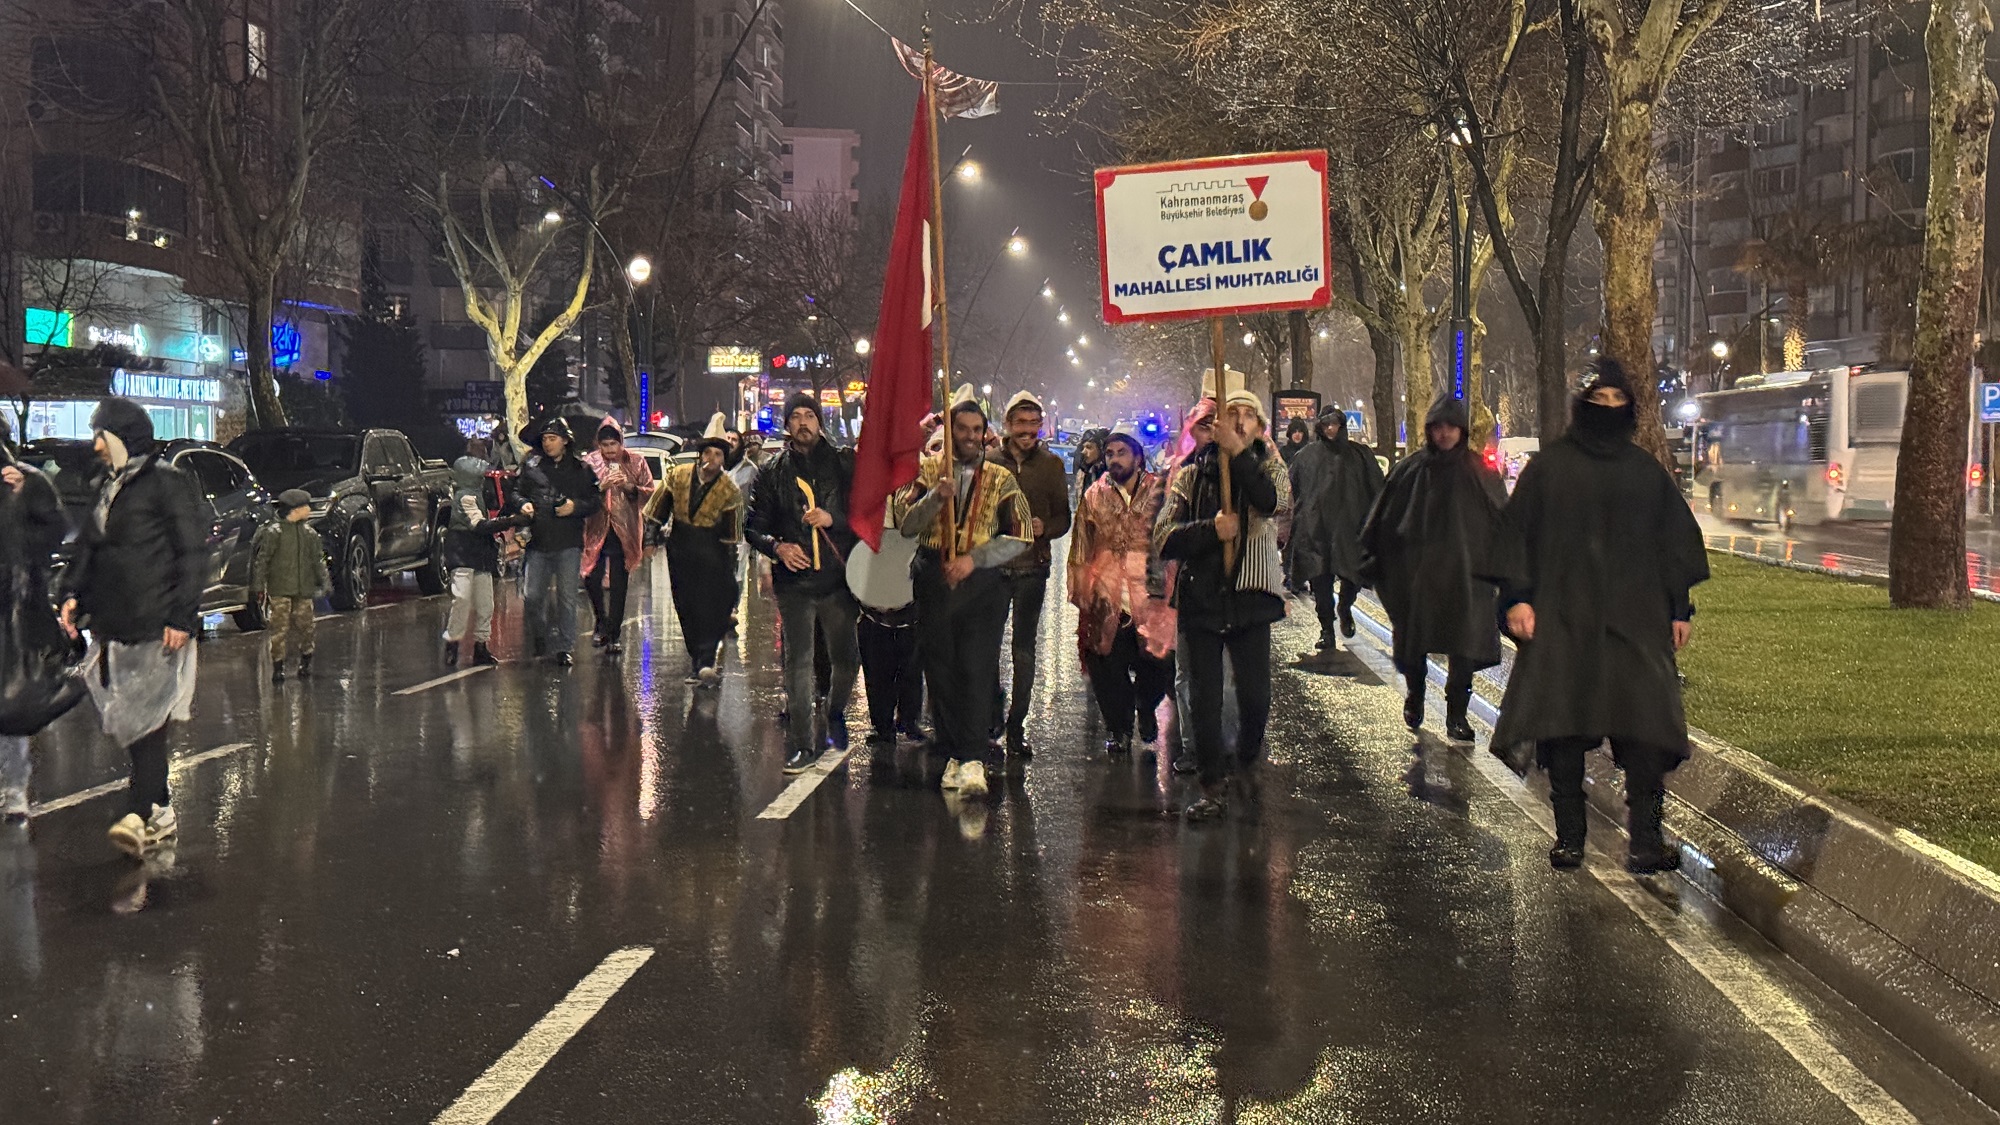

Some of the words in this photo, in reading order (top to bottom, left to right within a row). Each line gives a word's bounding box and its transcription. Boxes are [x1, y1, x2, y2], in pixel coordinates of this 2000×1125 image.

[1160, 193, 1244, 209] Kahramanmaraş
[1160, 208, 1203, 222] Büyükşehir
[1206, 205, 1245, 217] Belediyesi
[1158, 237, 1272, 273] ÇAMLIK
[1114, 273, 1211, 297] MAHALLESİ
[1215, 265, 1319, 290] MUHTARLIĞI
[1985, 386, 2000, 407] P
